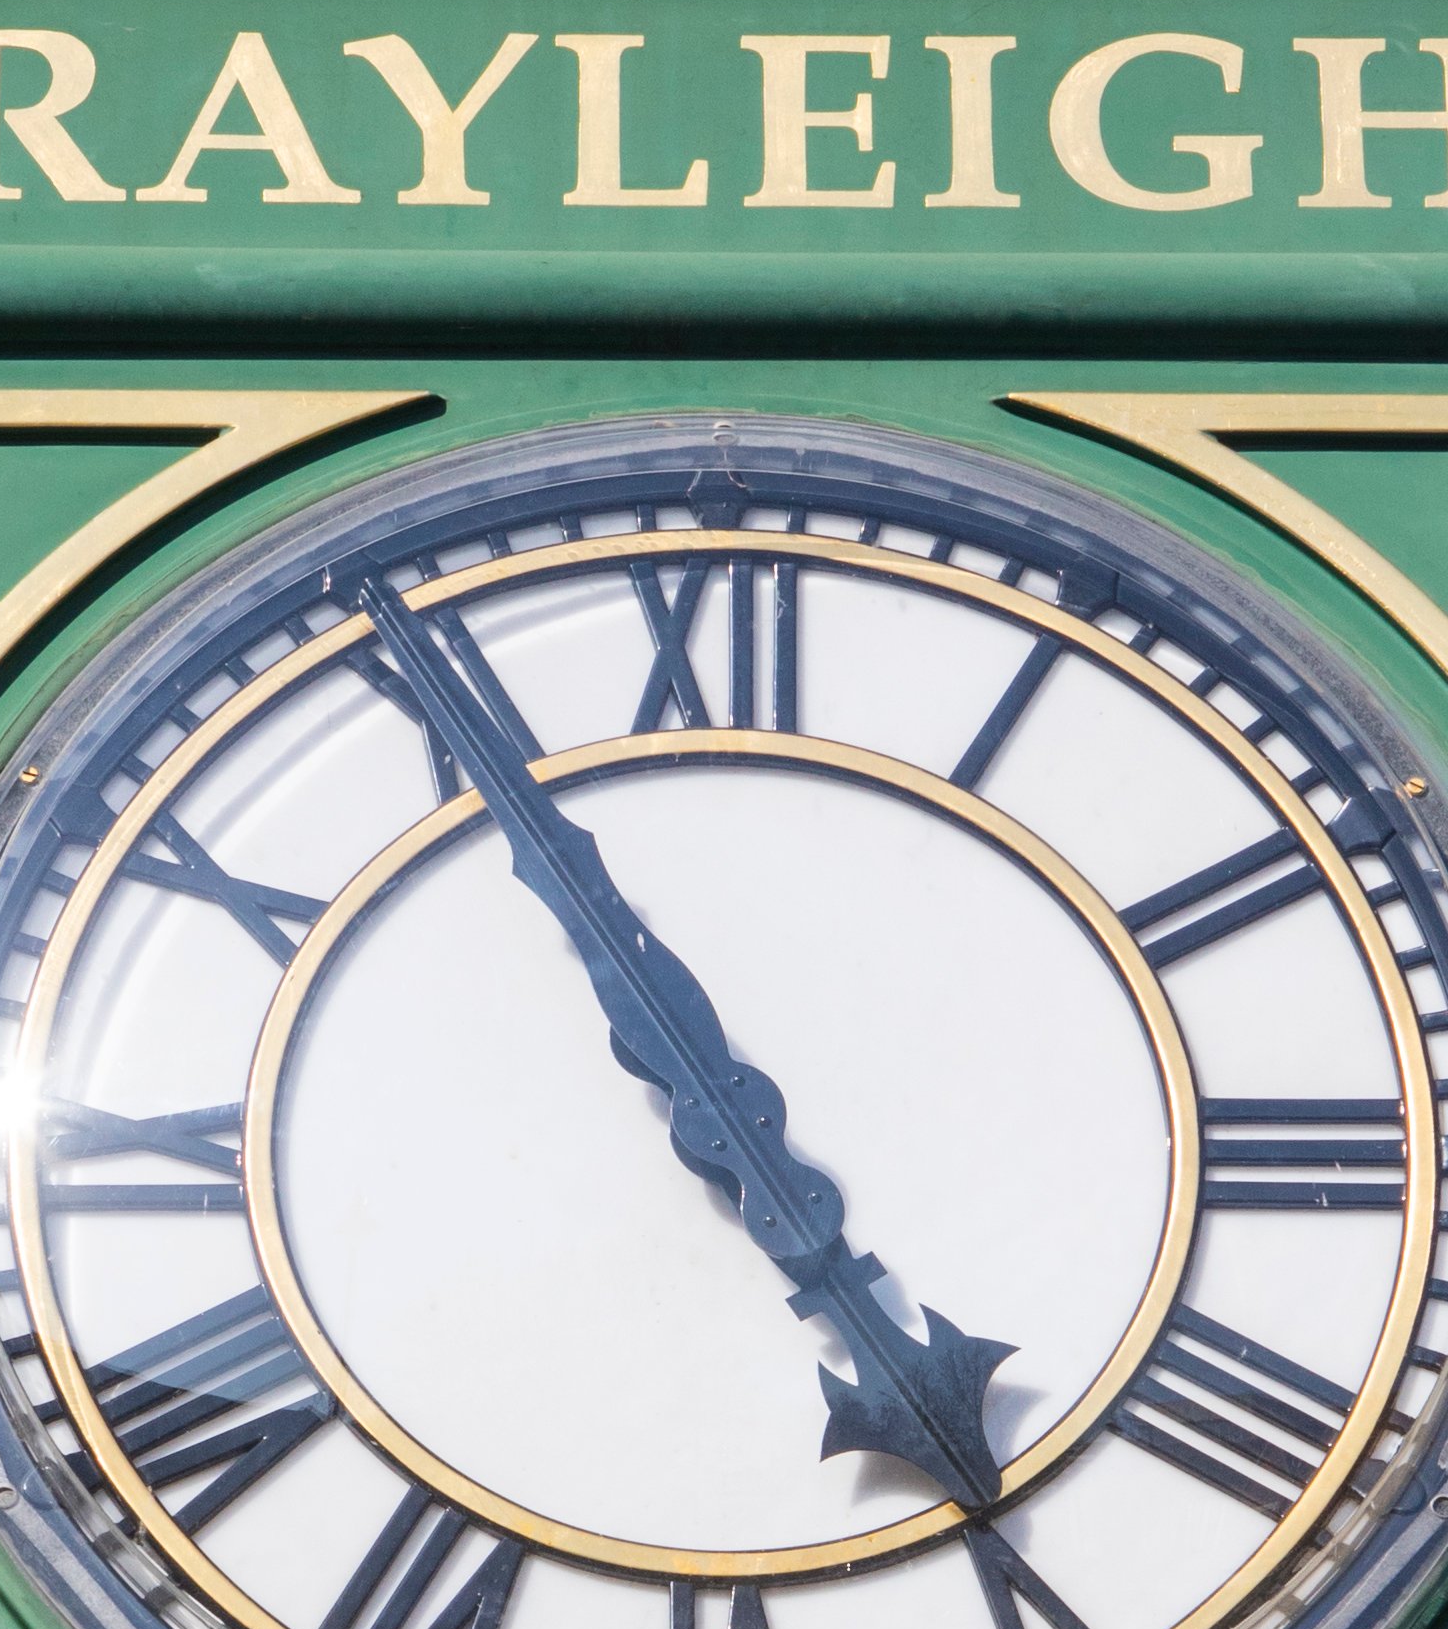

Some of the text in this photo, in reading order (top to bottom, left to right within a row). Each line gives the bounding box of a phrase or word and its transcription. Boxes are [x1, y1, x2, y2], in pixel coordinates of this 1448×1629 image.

[629, 559, 798, 735] XII
[948, 633, 1063, 792] I
[110, 809, 334, 969] X
[1116, 825, 1328, 972] II
[42, 1095, 248, 1212] IX
[1199, 1096, 1409, 1212] III
[82, 1283, 338, 1537] VIII
[1105, 1303, 1358, 1521] IIII
